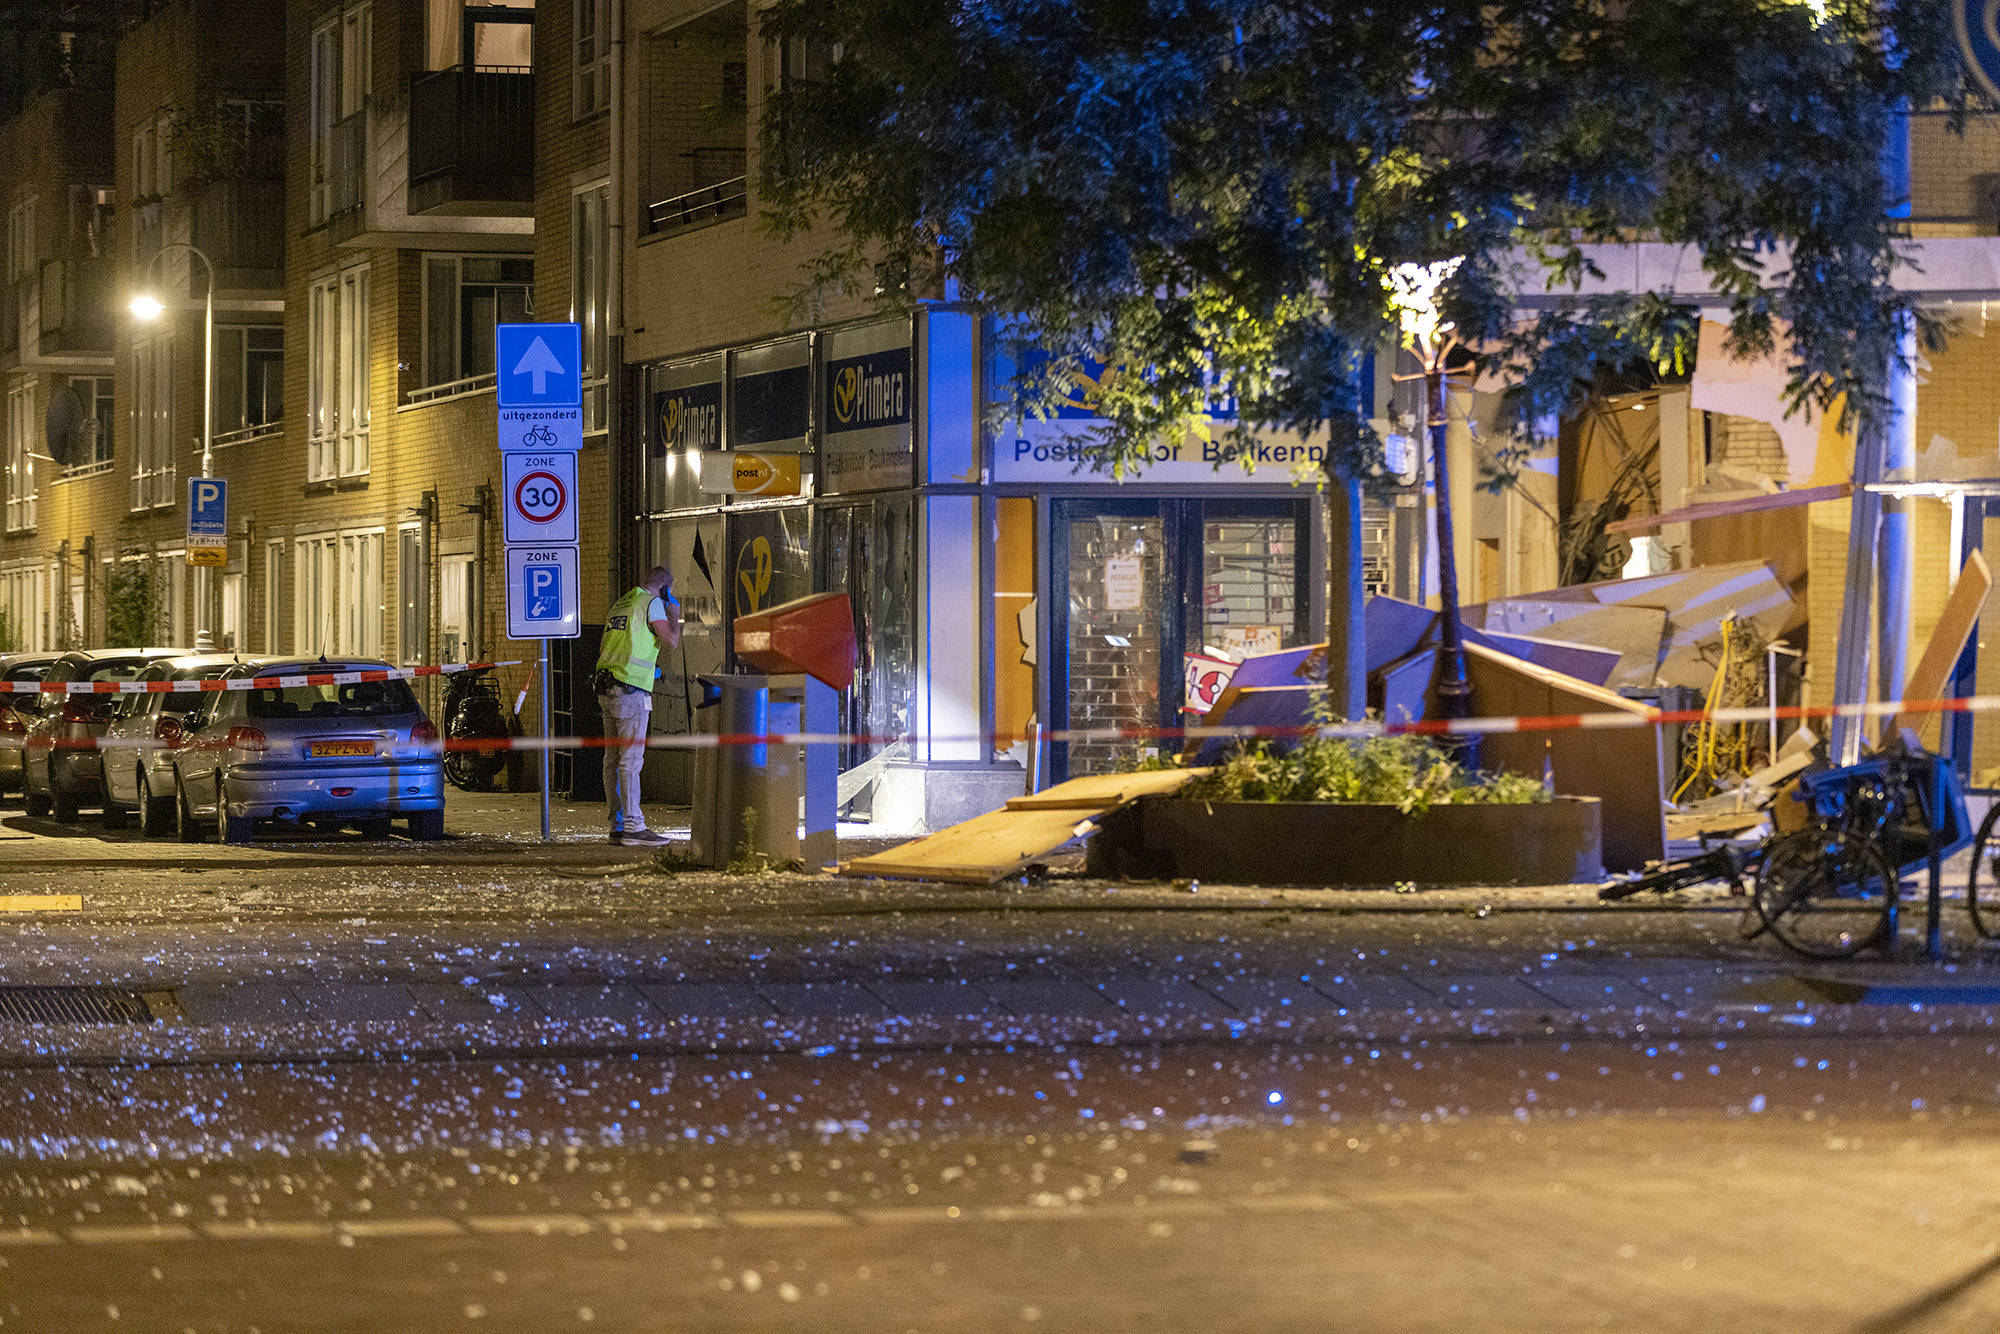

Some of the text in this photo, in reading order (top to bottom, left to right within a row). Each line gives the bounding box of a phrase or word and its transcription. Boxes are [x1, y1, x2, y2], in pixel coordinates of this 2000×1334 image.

[857, 364, 903, 422] Primera
[502, 410, 577, 423] uitgezonderd
[677, 395, 716, 447] Primera
[525, 457, 555, 467] ZONE
[736, 468, 768, 479] postnl
[197, 483, 220, 512] P
[524, 487, 558, 508] 30
[526, 552, 558, 562] ZONE
[533, 569, 553, 597] P
